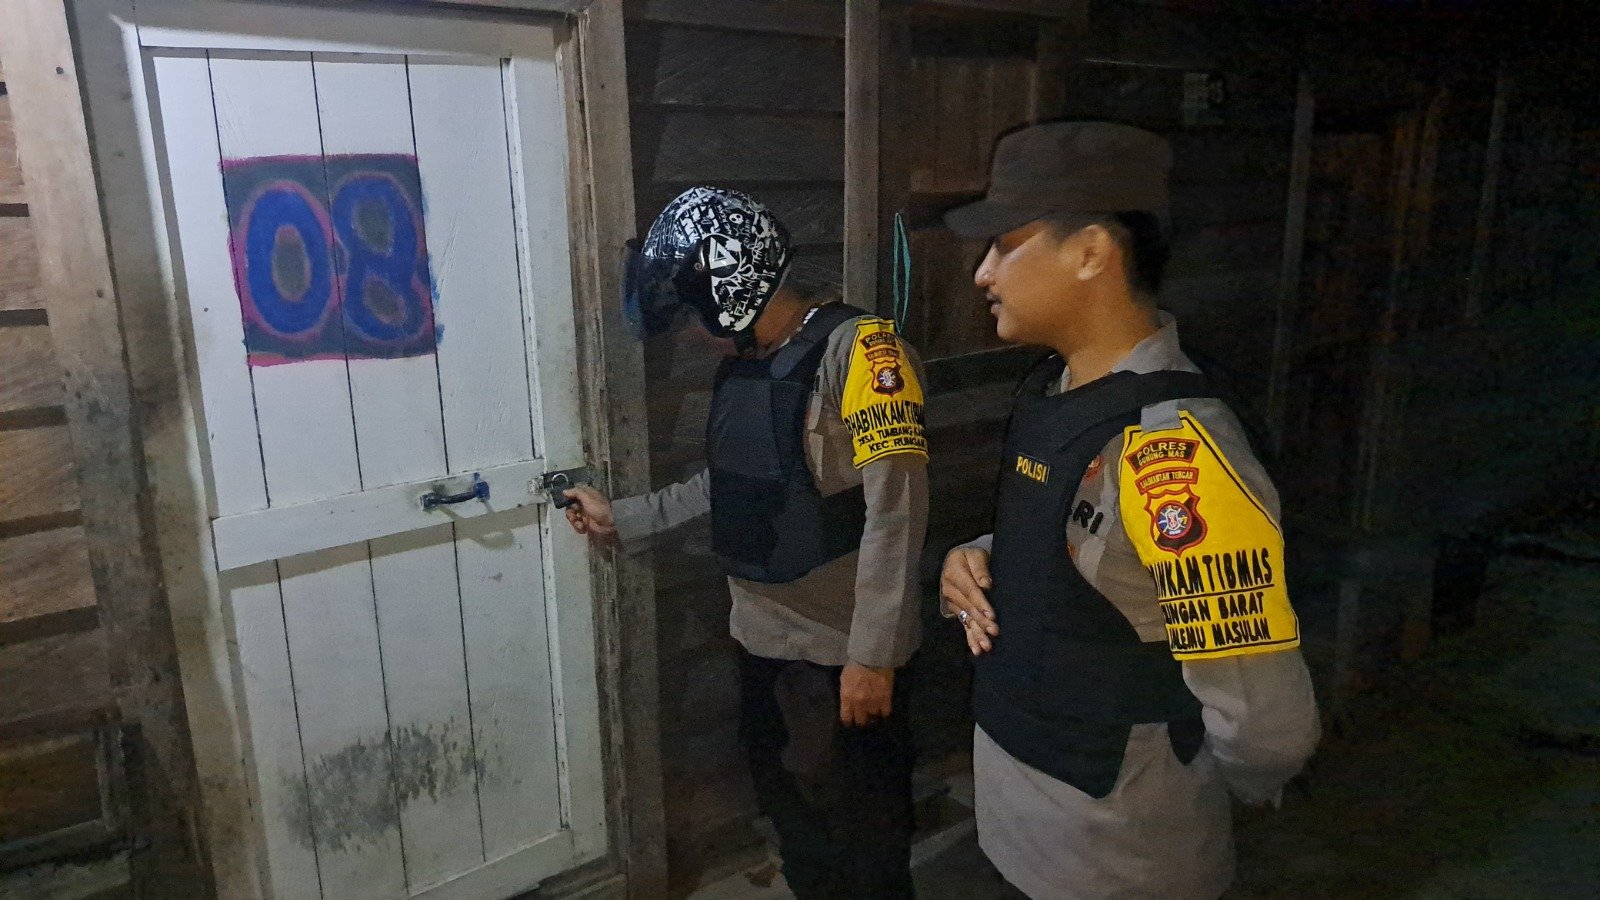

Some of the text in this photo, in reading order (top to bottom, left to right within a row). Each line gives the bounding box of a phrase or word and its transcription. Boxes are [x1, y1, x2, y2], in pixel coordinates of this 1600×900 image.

[246, 174, 427, 341] 08
[844, 400, 924, 440] HABINKAMTIB
[876, 426, 913, 440] TUMBANG
[1136, 441, 1187, 461] POLRES
[1138, 450, 1185, 467] GUNUNG MAS
[1016, 456, 1047, 483] POLISI
[1069, 499, 1104, 534] RI
[1146, 547, 1273, 598] INKAMTIBMAS
[1218, 591, 1264, 619] BARAT
[1212, 617, 1272, 647] MASULAN
